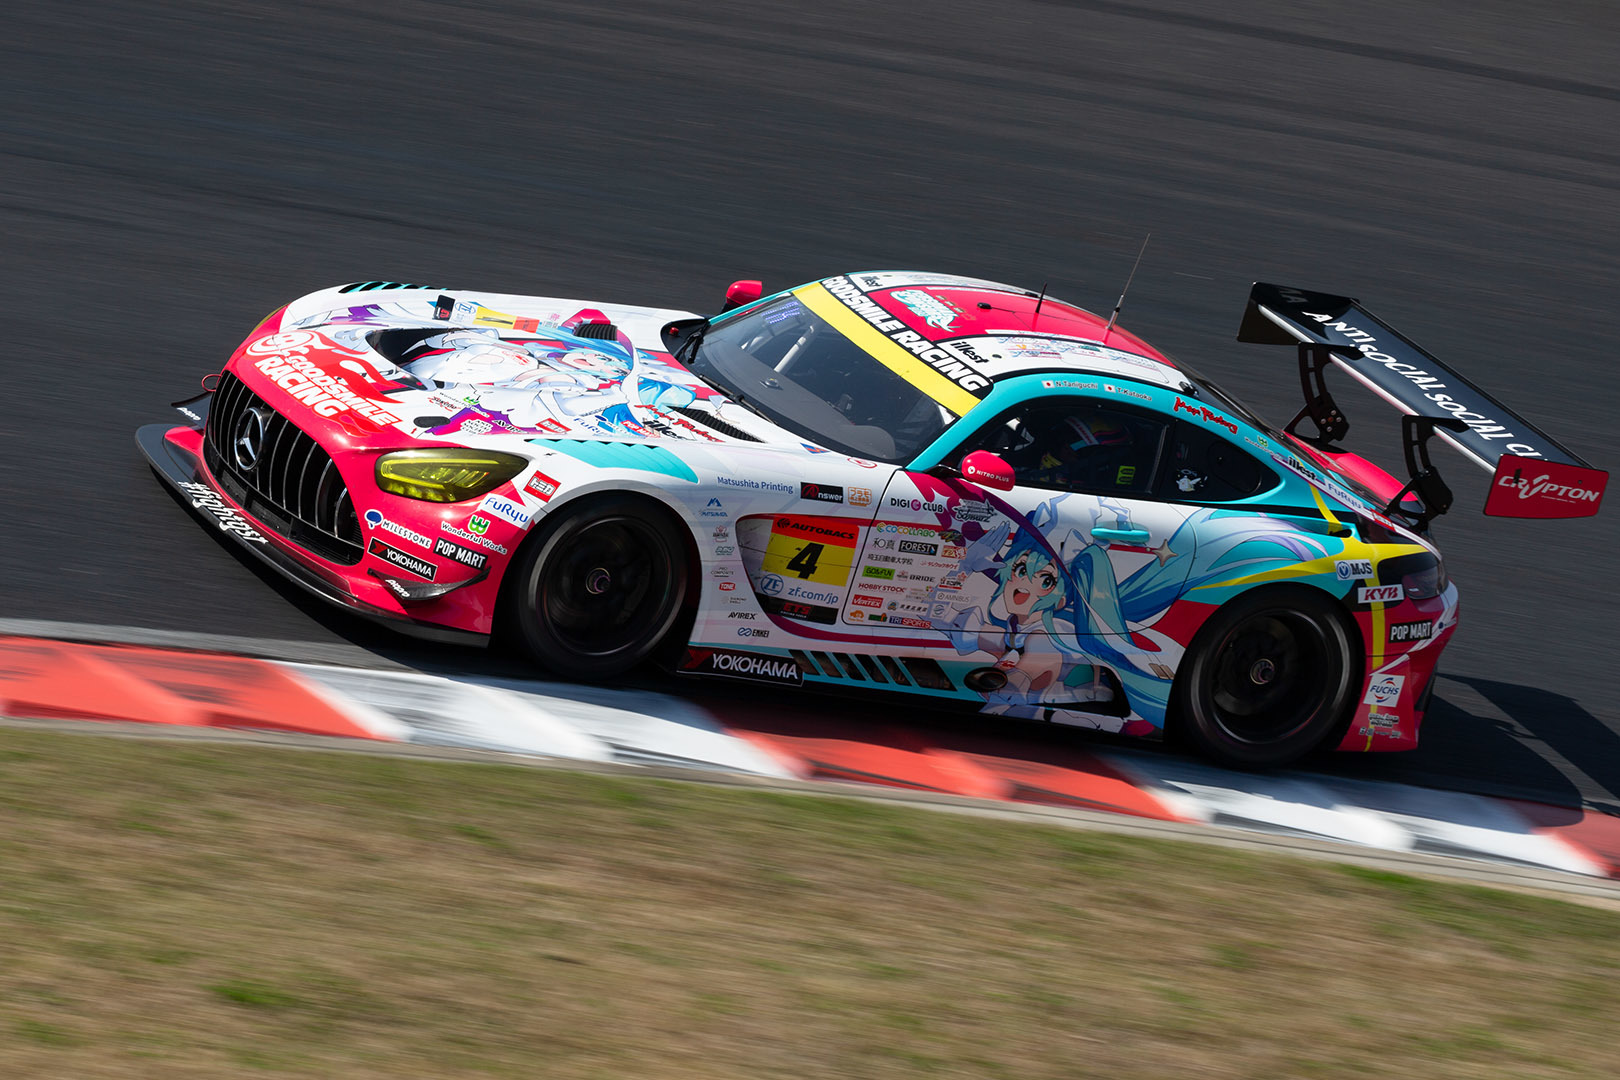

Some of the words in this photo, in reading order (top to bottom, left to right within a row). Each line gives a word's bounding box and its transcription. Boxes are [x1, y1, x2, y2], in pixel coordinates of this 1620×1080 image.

[950, 341, 989, 364] illest
[890, 330, 990, 392] RACING
[1303, 311, 1376, 345] ANTI
[1360, 344, 1448, 390] SOCIAL
[1425, 392, 1514, 441] SOCIAL
[254, 356, 349, 417] RACING
[976, 470, 995, 479] NITRO
[1288, 456, 1317, 481] illest
[717, 476, 759, 489] Matsushita
[761, 481, 794, 494] Printing
[1498, 474, 1600, 503] CRYPTON
[1328, 483, 1363, 510] FuRyu
[484, 497, 529, 524] FuRyu
[890, 498, 910, 508] DIGI
[923, 502, 943, 513] CLUB
[382, 520, 432, 548] MILESTONE
[441, 522, 482, 544] Wonderful
[483, 537, 508, 554] Works
[791, 523, 856, 539] AUTOBACS
[885, 525, 936, 538] COCOLLABO
[872, 537, 895, 550] 和真
[901, 542, 930, 553] FOREST
[436, 540, 455, 557] POP
[455, 548, 486, 569] MART
[786, 542, 824, 579] 4
[386, 549, 433, 577] YOKOHAMA
[1350, 562, 1373, 575] MJS
[764, 576, 780, 590] ZF
[909, 574, 935, 583] BRIDE
[788, 587, 839, 604] zf.com/jp
[858, 582, 881, 591] HOBBY
[883, 585, 905, 593] STOCK
[1364, 586, 1398, 601] KYB
[783, 602, 812, 615] ETS
[853, 597, 881, 607] VERTEX
[728, 611, 756, 620] AVIREX
[889, 616, 902, 625] TRI
[902, 618, 931, 628] SPORTS
[752, 629, 770, 638] ENKEI
[1391, 625, 1408, 641] POP
[1410, 621, 1432, 639] MART
[713, 653, 798, 680] YOKOHAMA
[1370, 684, 1400, 696] FUCHS
